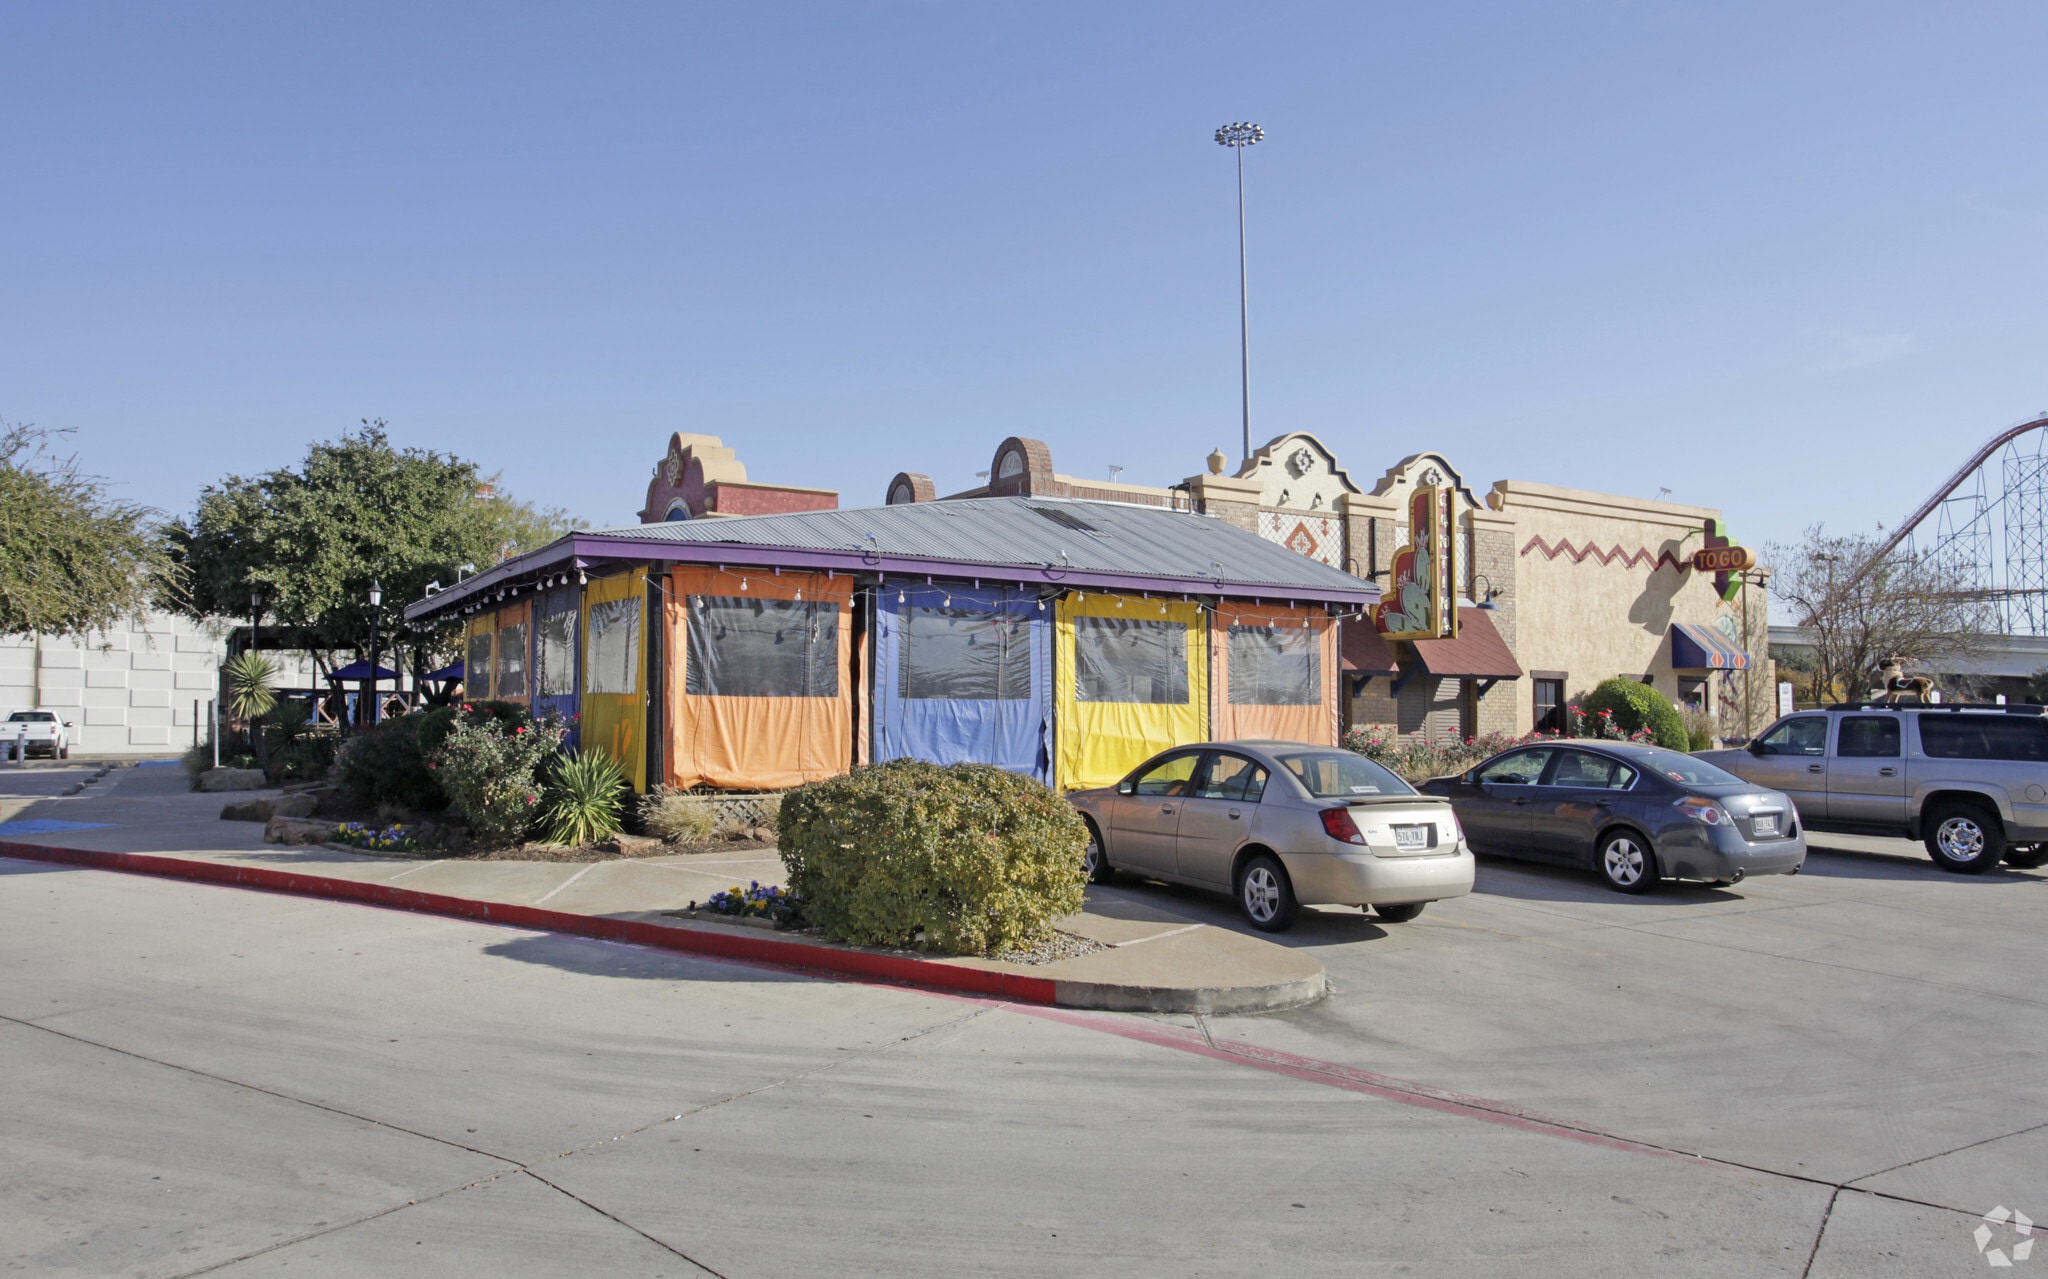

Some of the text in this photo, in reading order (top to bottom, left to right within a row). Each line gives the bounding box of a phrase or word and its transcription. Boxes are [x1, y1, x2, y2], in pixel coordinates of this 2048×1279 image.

[1438, 492, 1452, 632] CANTINA
[1697, 550, 1743, 569] TO GO
